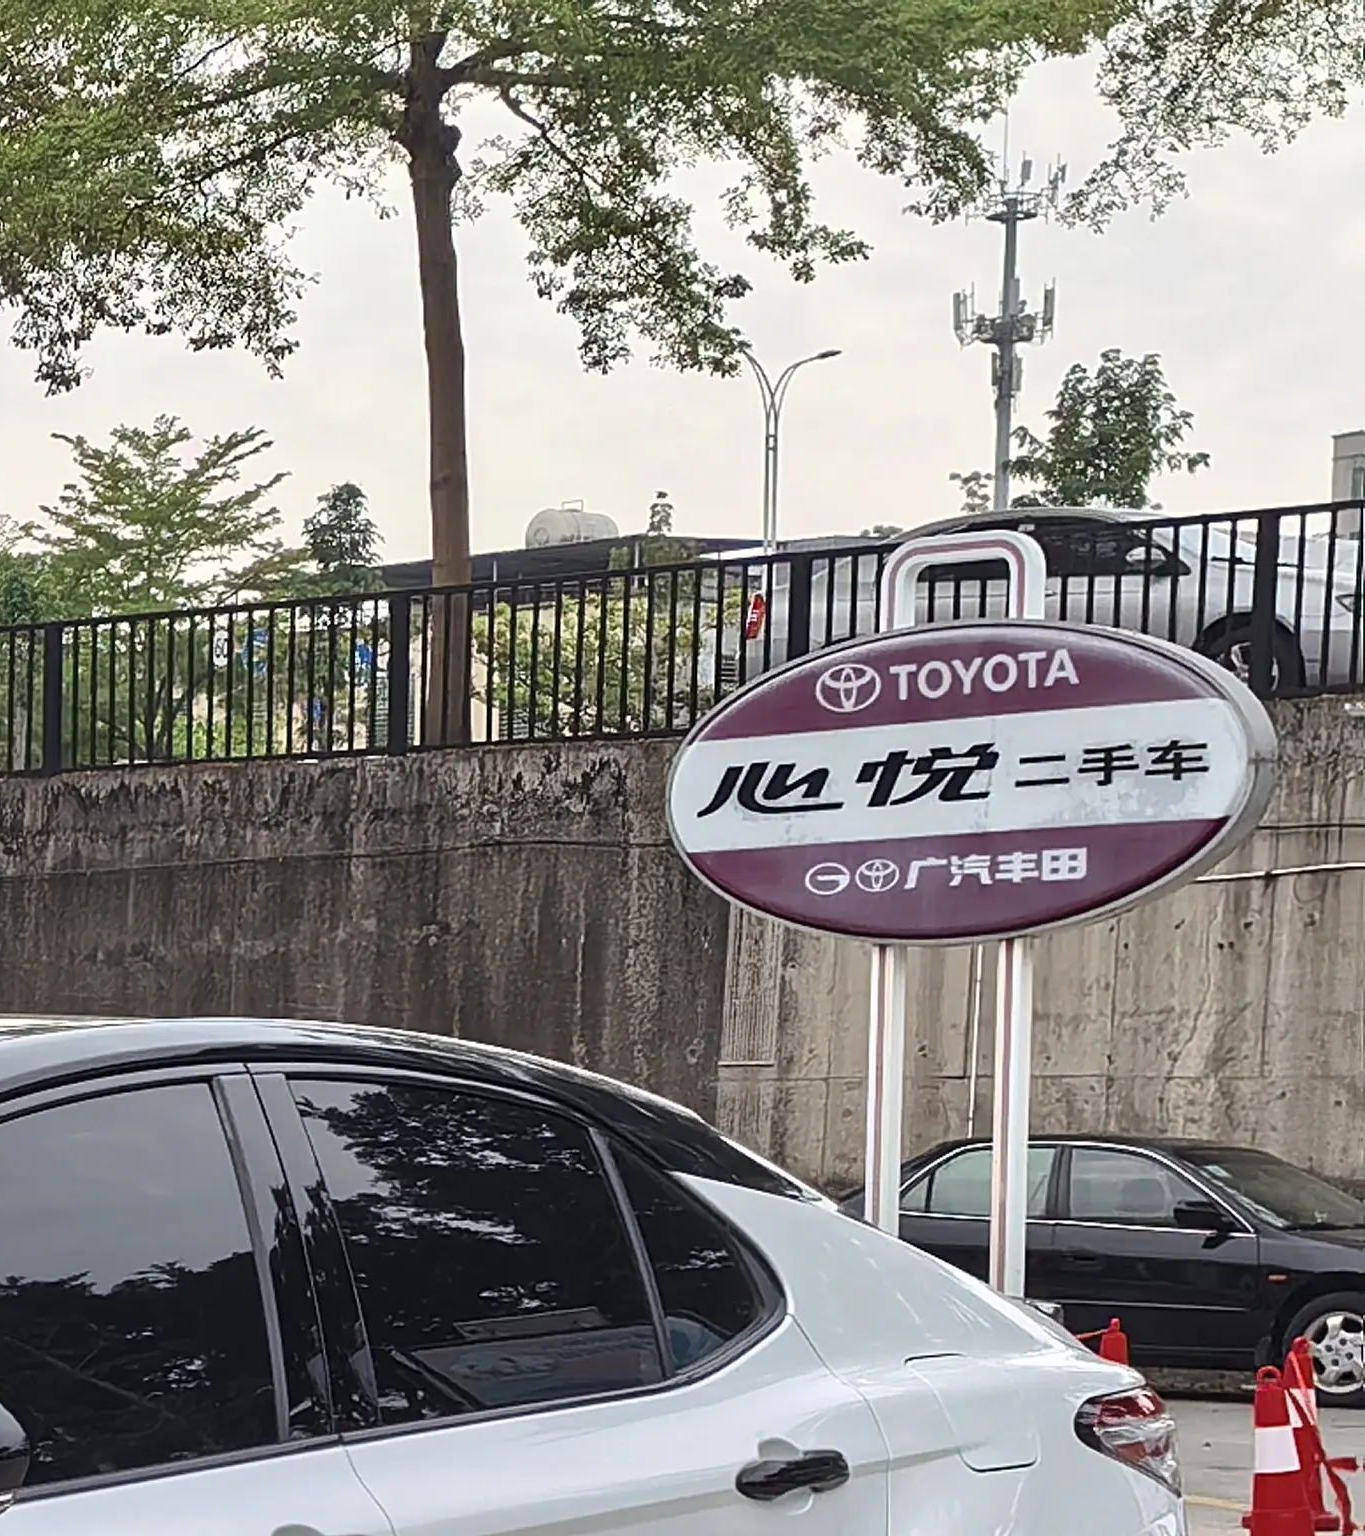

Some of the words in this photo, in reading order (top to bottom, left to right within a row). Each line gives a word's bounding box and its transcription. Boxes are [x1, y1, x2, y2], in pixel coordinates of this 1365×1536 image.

[889, 648, 1080, 701] TOYOTA
[904, 846, 1088, 890] 广汽丰田
